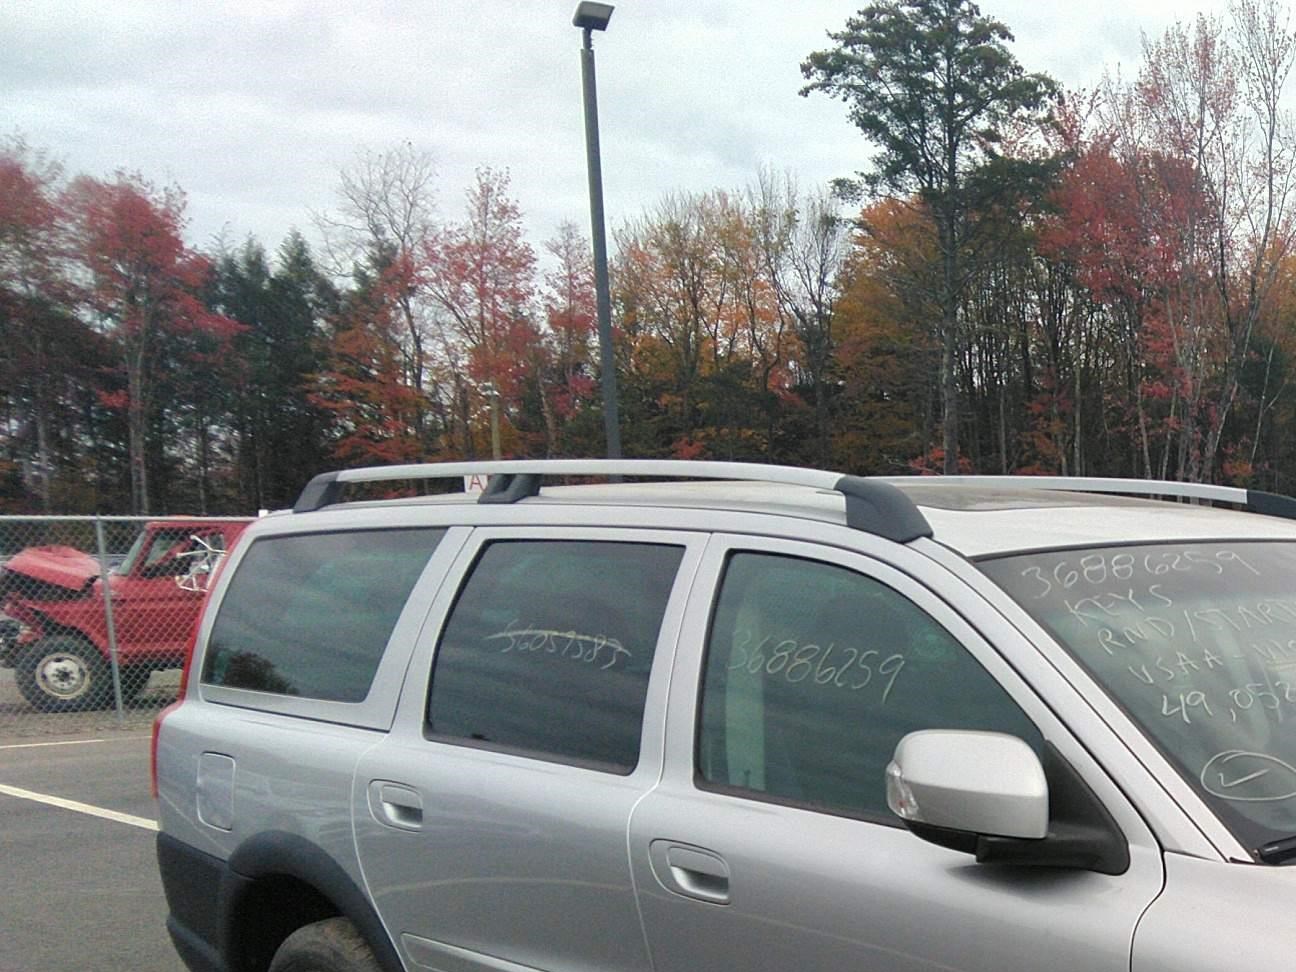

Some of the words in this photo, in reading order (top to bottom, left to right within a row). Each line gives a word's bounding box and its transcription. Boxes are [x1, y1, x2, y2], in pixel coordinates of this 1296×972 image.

[1021, 550, 1261, 599] 36886259
[1063, 583, 1174, 627] KEYS
[727, 629, 906, 704] 36886259
